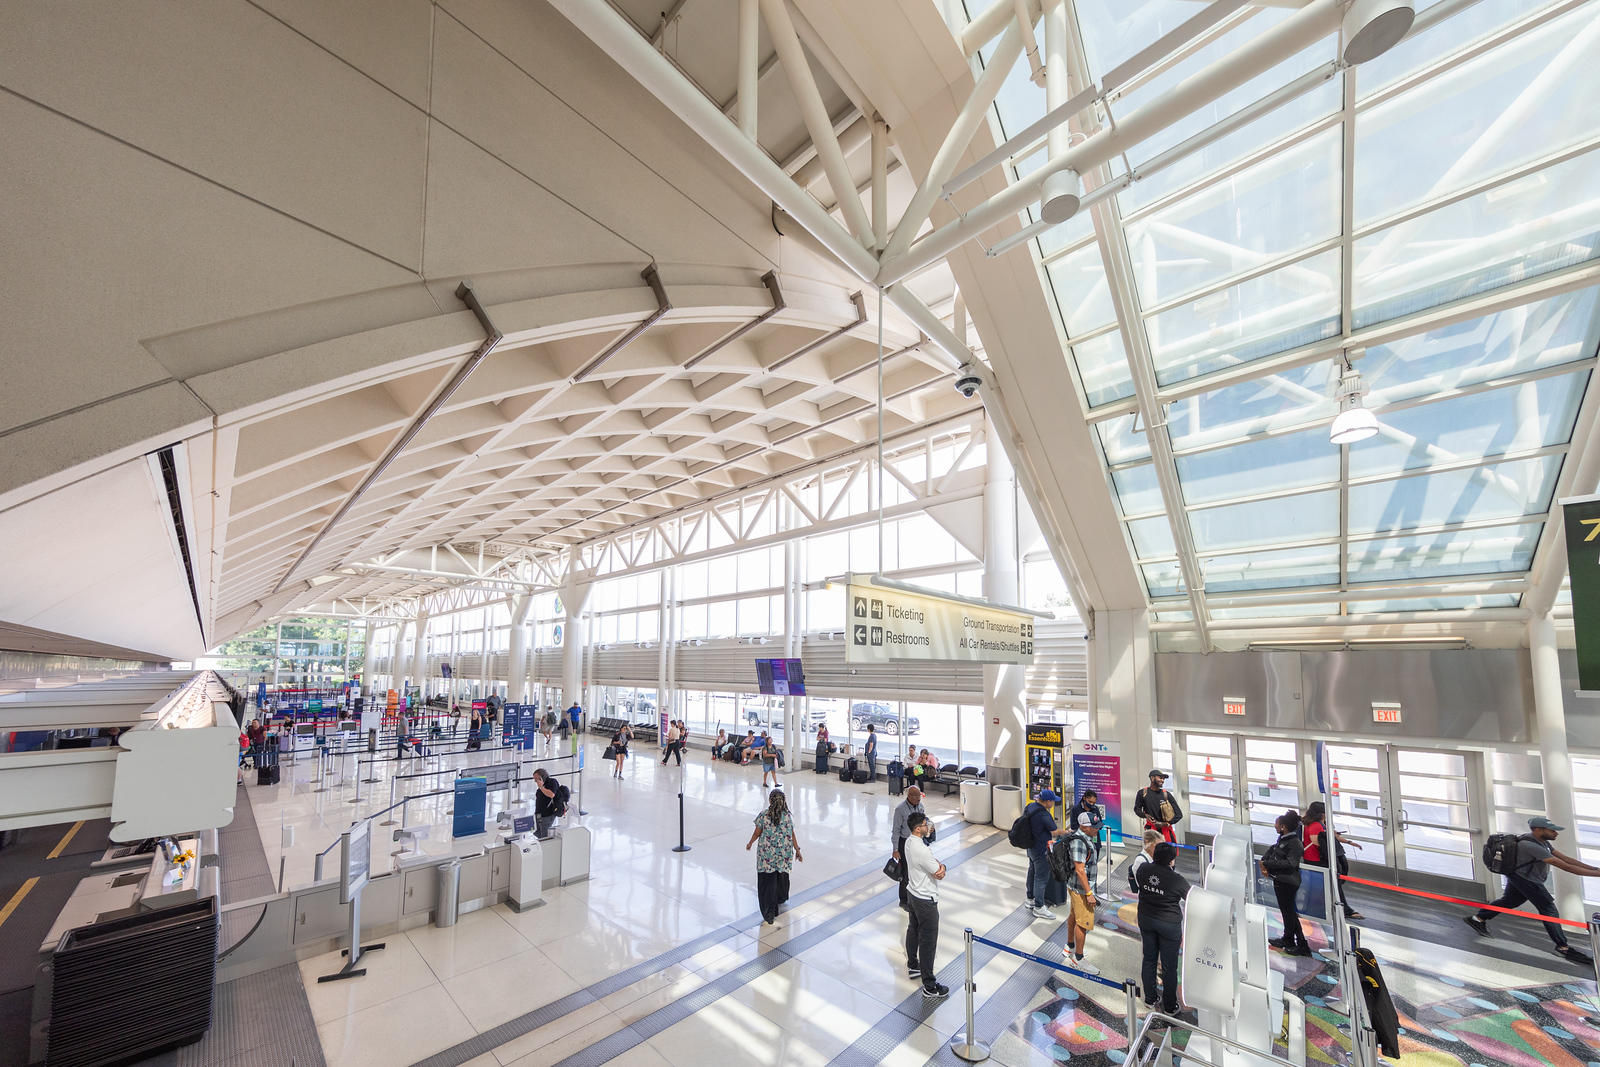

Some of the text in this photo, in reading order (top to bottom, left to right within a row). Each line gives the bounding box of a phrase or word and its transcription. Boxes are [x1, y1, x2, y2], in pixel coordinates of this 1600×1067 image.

[887, 604, 924, 624] Ticketing
[963, 616, 1020, 633] Ground Transportation
[886, 630, 930, 646] Restrooms
[959, 637, 968, 648] All
[969, 638, 980, 649] Car
[1227, 704, 1243, 714] EXIT
[1377, 710, 1398, 721] EXIT
[1143, 884, 1165, 895] CLEAR
[1195, 957, 1224, 970] CLEAR
